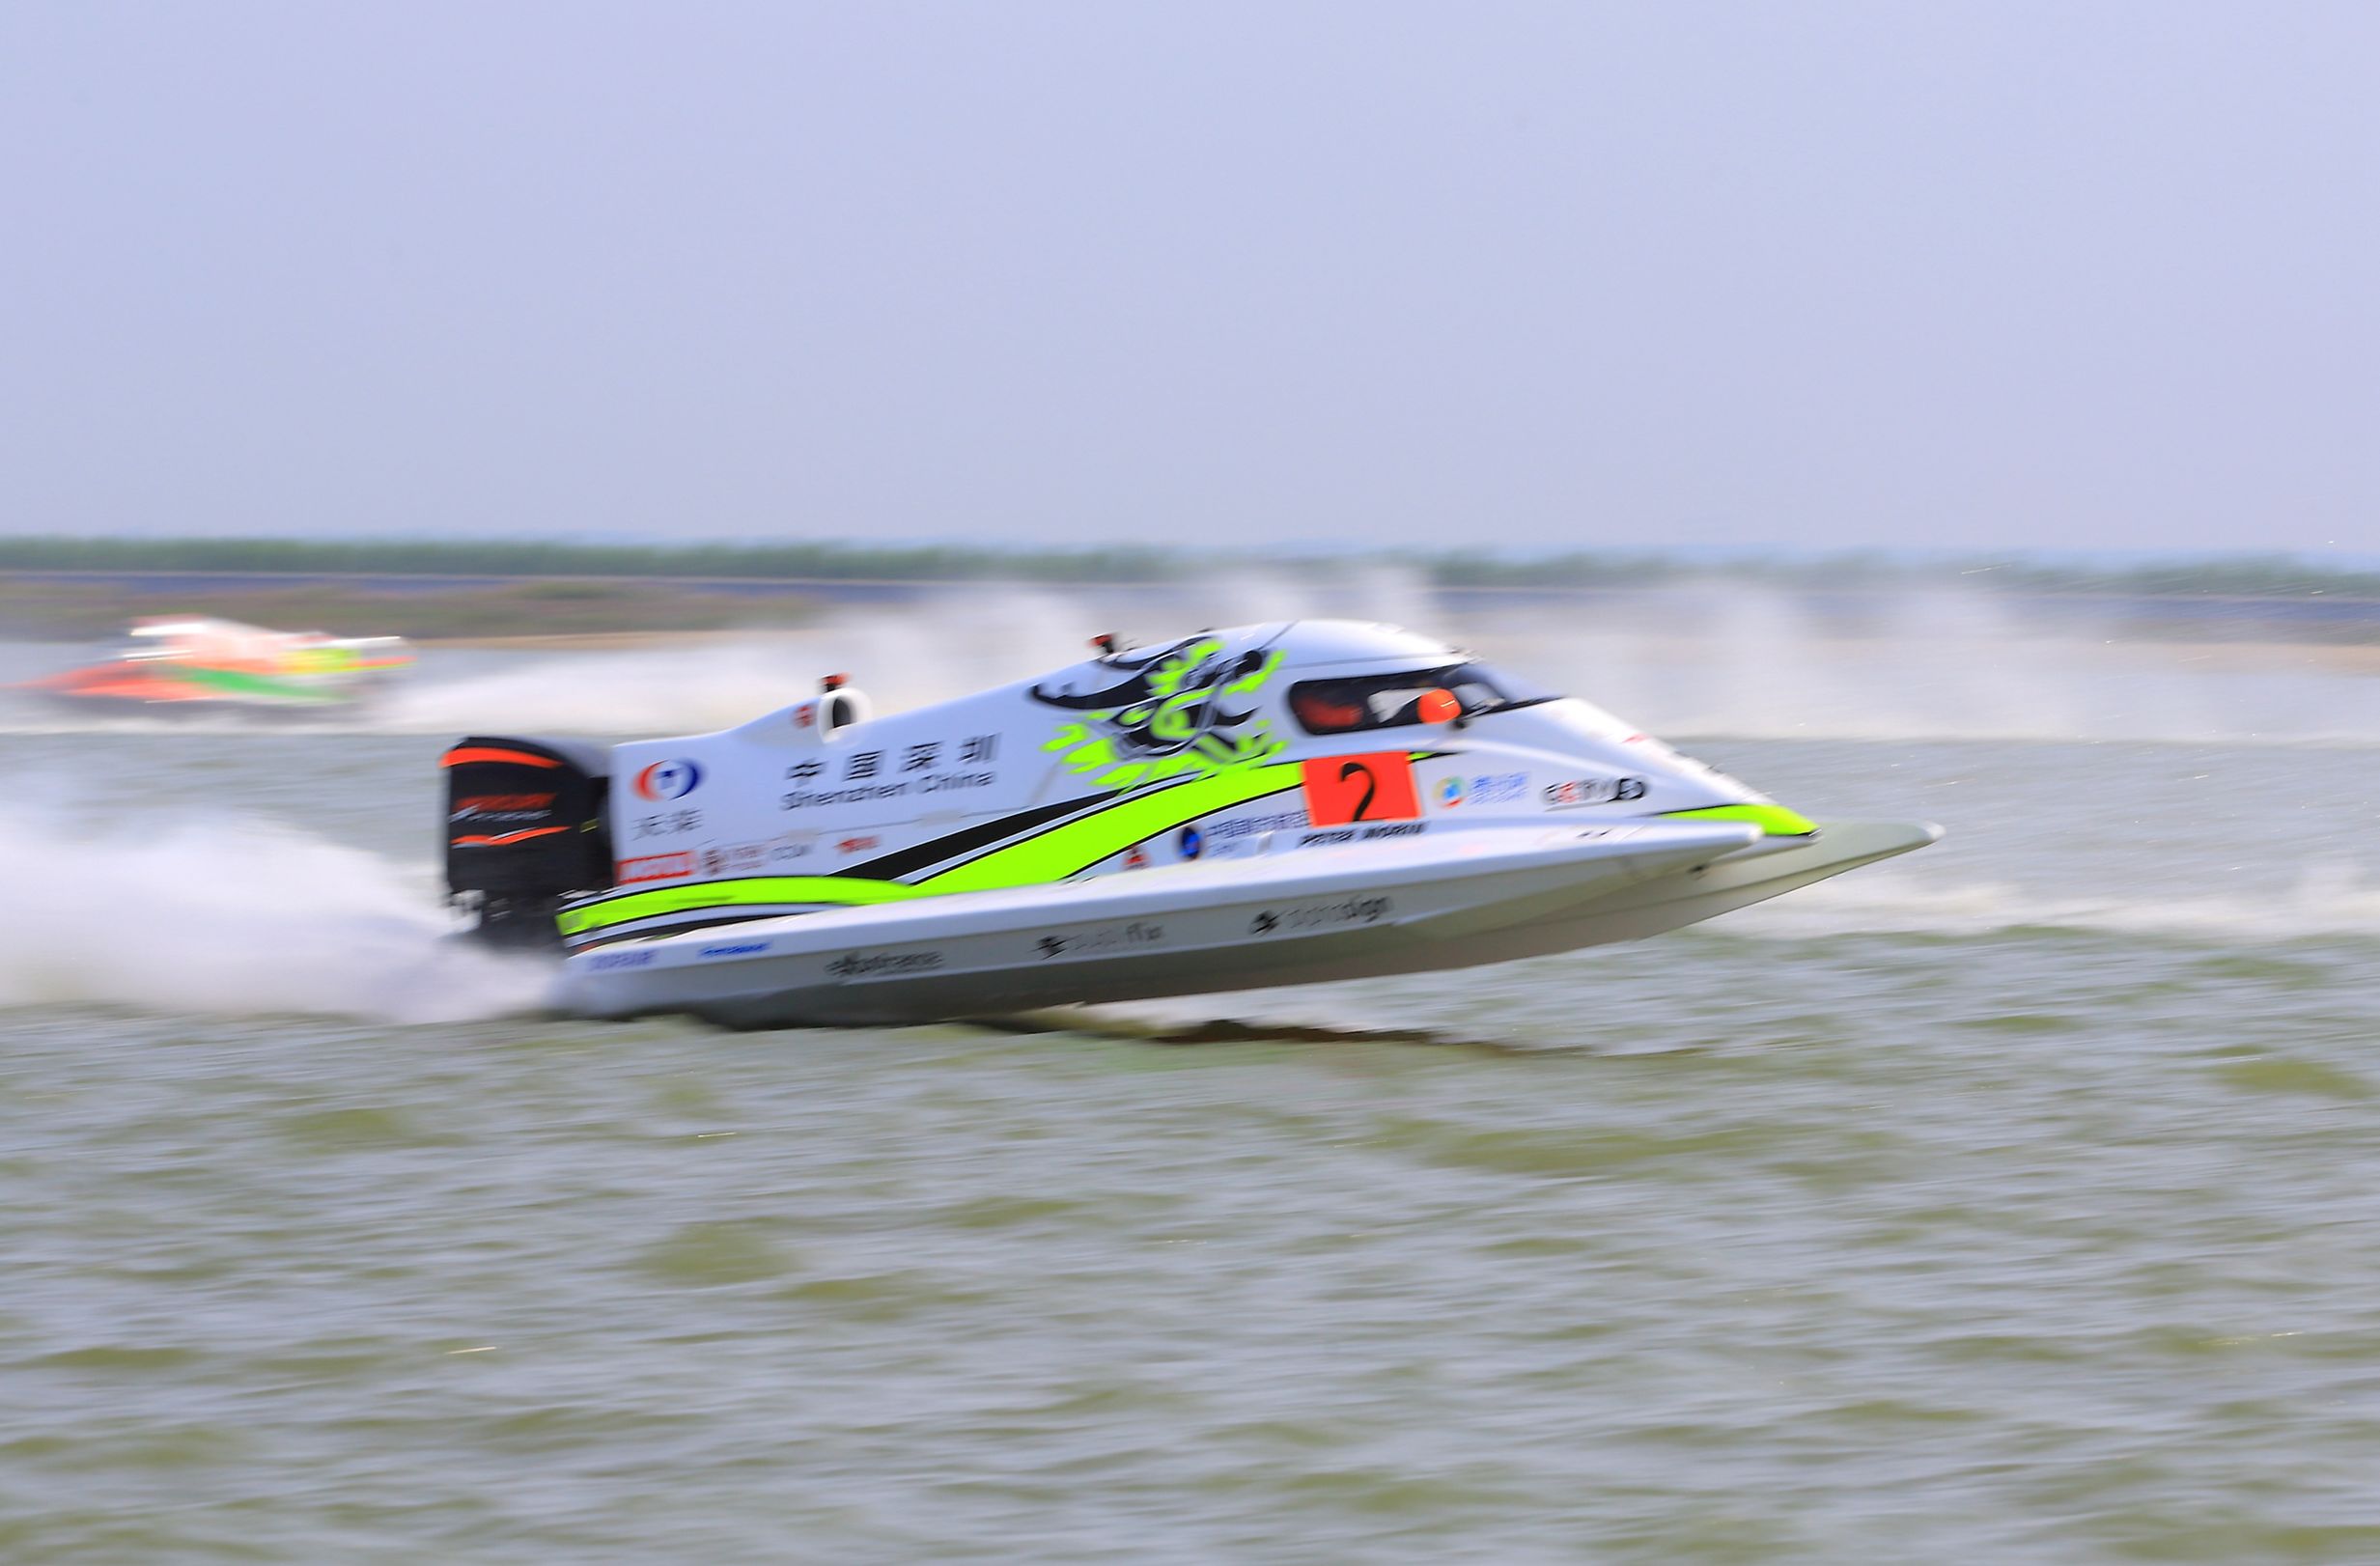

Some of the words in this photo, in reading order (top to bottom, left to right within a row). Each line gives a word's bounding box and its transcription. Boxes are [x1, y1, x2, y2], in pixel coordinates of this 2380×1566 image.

[787, 733, 1001, 786] 中国深圳
[780, 780, 909, 812] Shenzhen
[919, 770, 995, 794] China
[1340, 762, 1387, 822] 2
